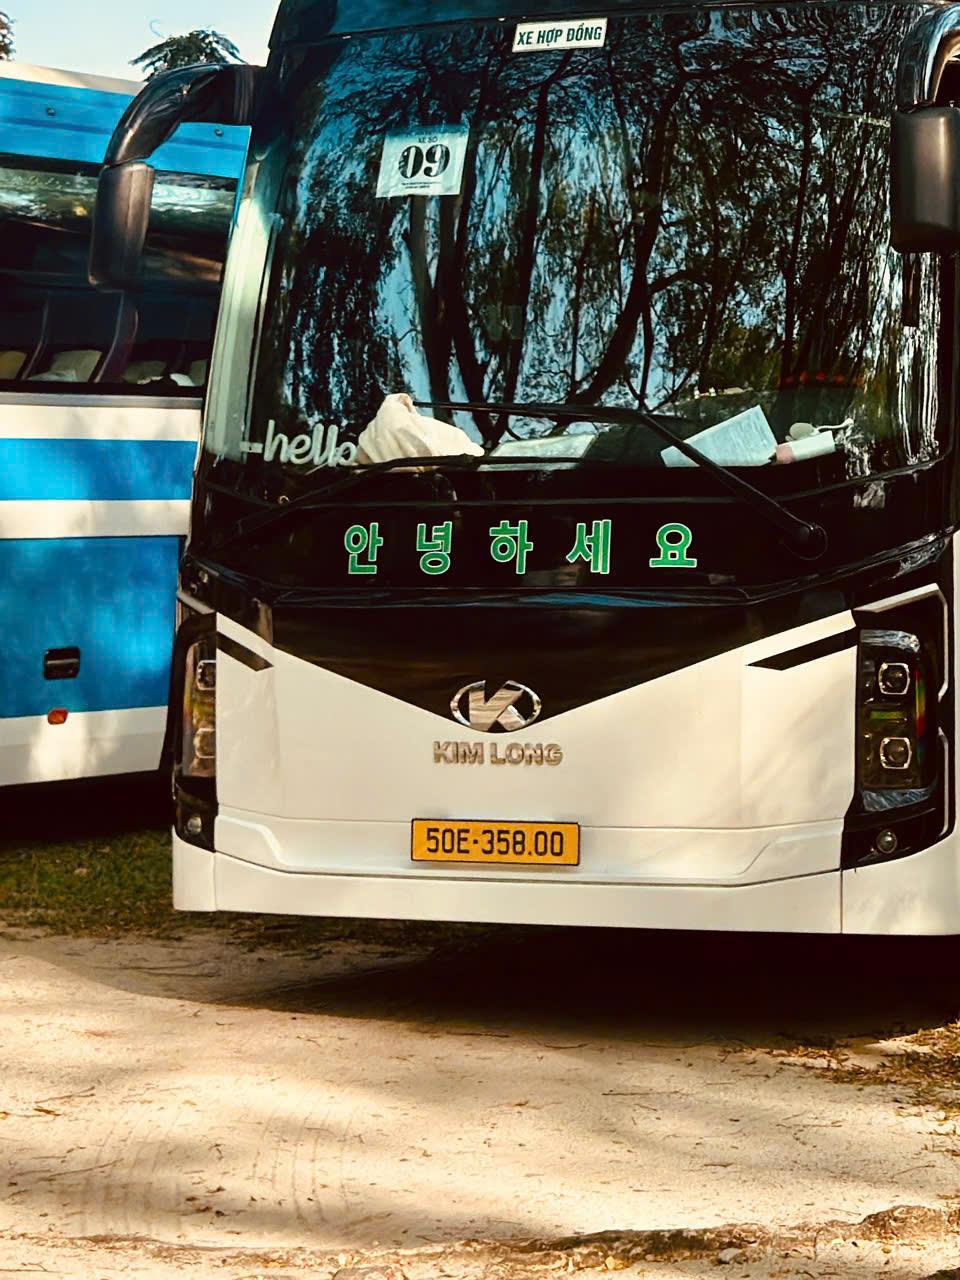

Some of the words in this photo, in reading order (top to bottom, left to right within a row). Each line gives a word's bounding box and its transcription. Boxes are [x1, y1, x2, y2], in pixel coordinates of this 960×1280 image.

[517, 31, 534, 45] XE
[537, 28, 563, 46] HỢP
[398, 144, 450, 179] 09
[264, 420, 358, 467] hello
[344, 520, 698, 575] 안녕하세요
[433, 741, 485, 765] KIM
[489, 742, 564, 766] LONG
